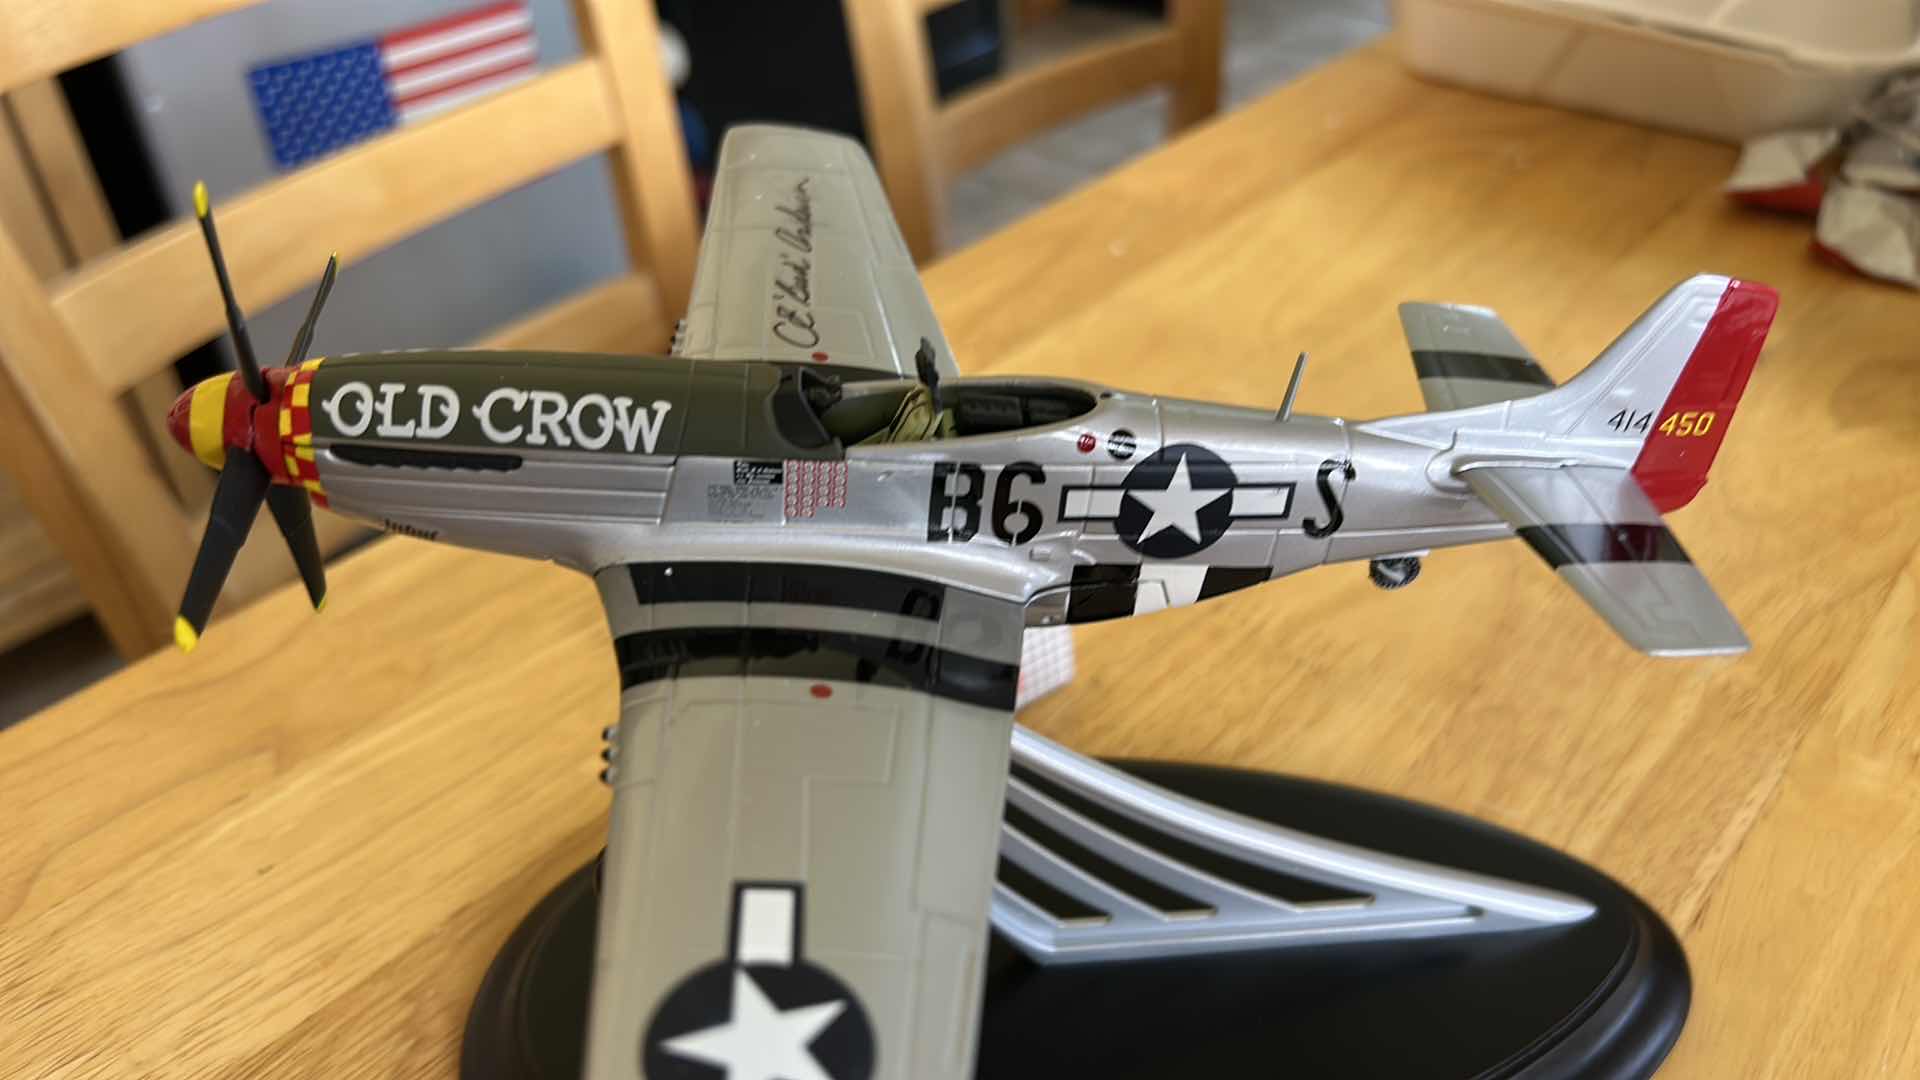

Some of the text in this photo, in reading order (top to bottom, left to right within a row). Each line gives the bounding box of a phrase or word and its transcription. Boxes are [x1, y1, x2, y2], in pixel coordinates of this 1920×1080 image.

[322, 381, 672, 454] OLD CROW
[1606, 408, 1716, 438] 414 450
[927, 461, 1047, 546] B6
[1302, 458, 1357, 540] S
